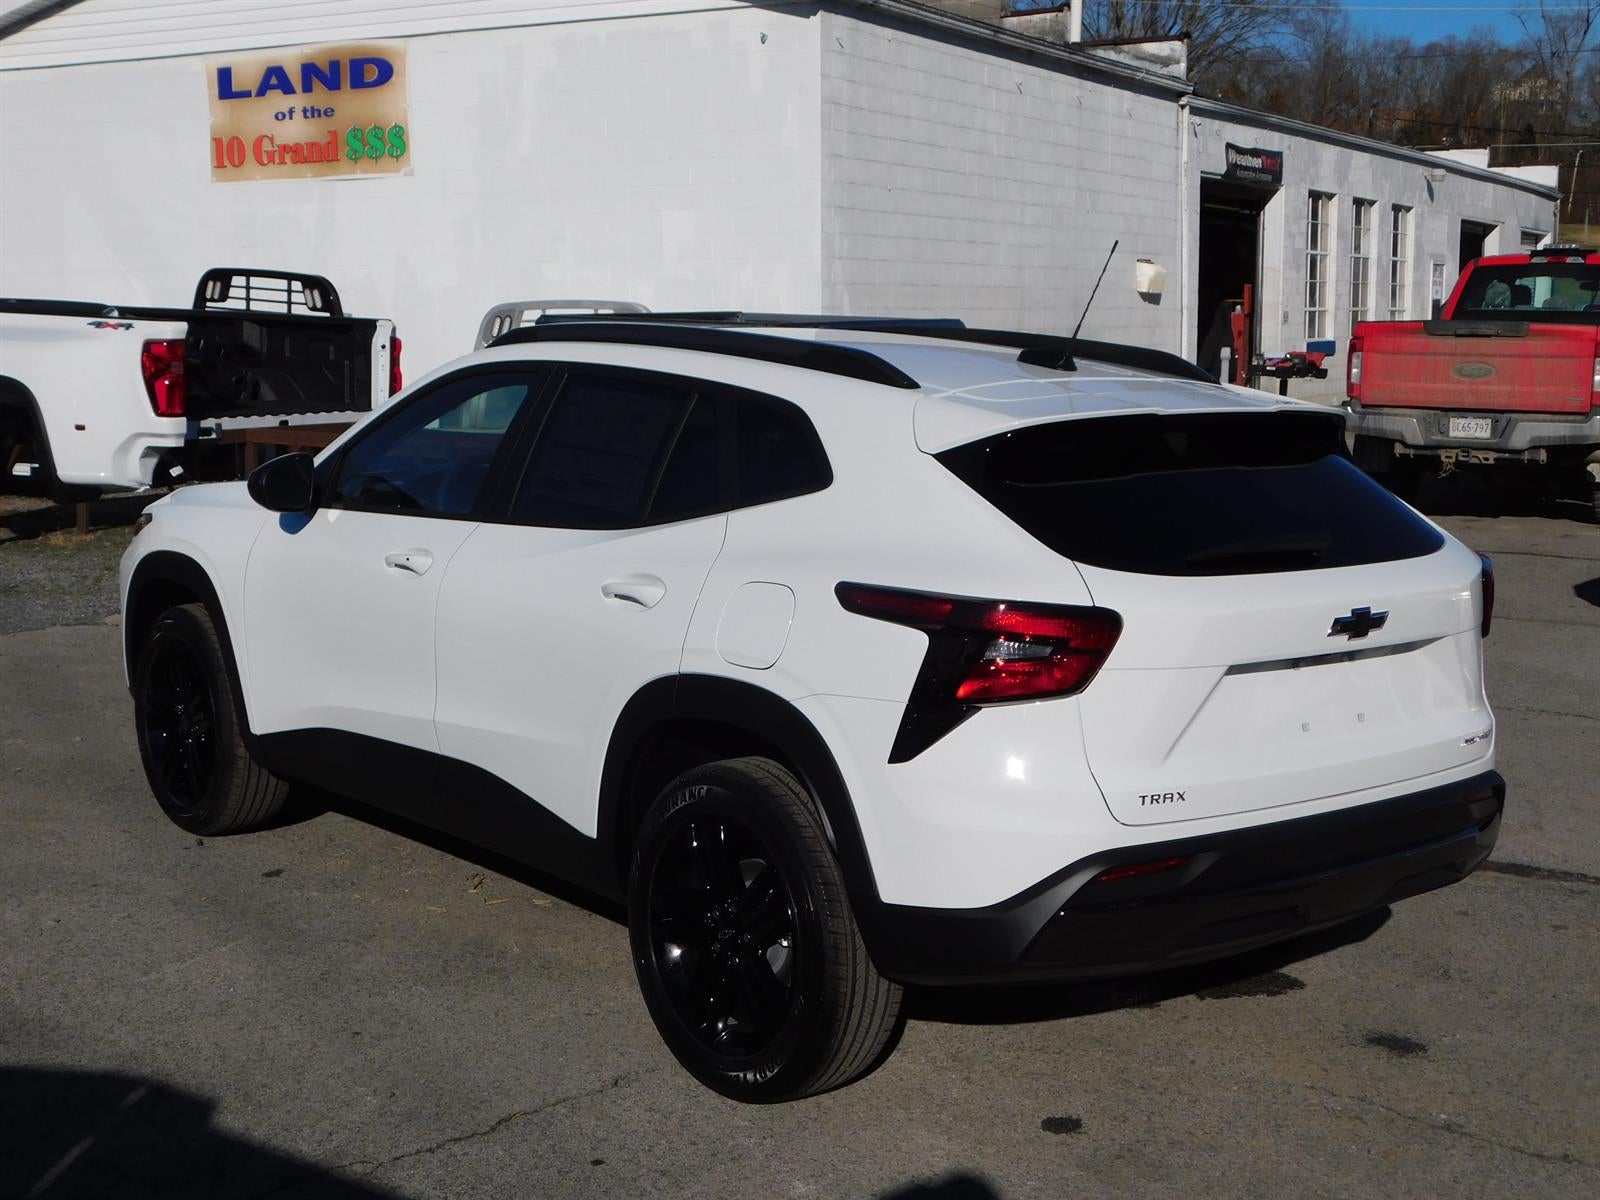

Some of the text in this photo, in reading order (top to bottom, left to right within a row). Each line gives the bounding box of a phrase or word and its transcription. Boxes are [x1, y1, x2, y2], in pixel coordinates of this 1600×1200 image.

[216, 57, 394, 101] LAND
[274, 105, 336, 122] of the
[212, 122, 407, 169] 10 Grand $$$
[1138, 790, 1187, 807] TRAX
